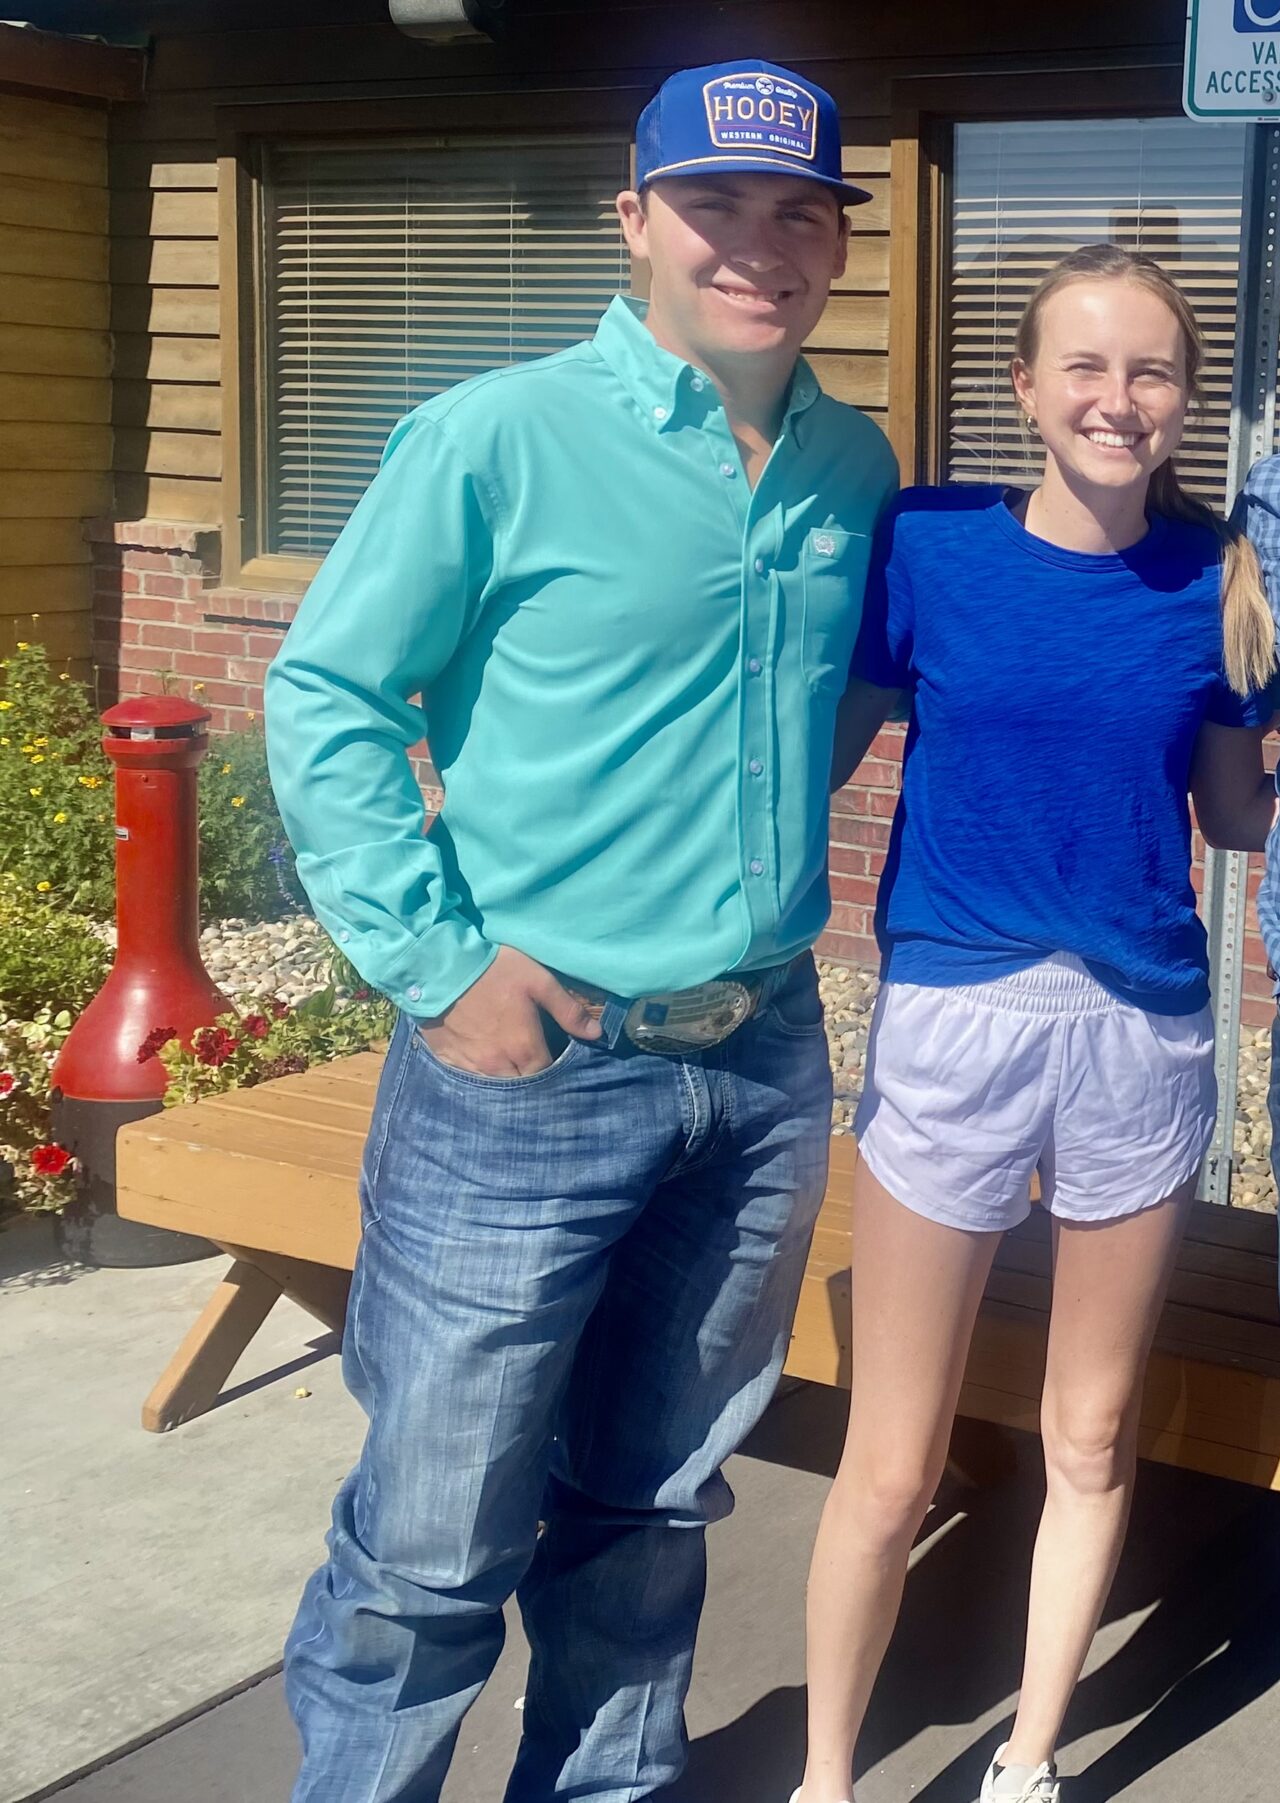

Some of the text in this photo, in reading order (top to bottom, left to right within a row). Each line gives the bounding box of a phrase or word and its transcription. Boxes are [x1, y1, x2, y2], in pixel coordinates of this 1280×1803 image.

[714, 95, 813, 131] HOOEY
[721, 131, 806, 150] WESTERN ORIGINAL
